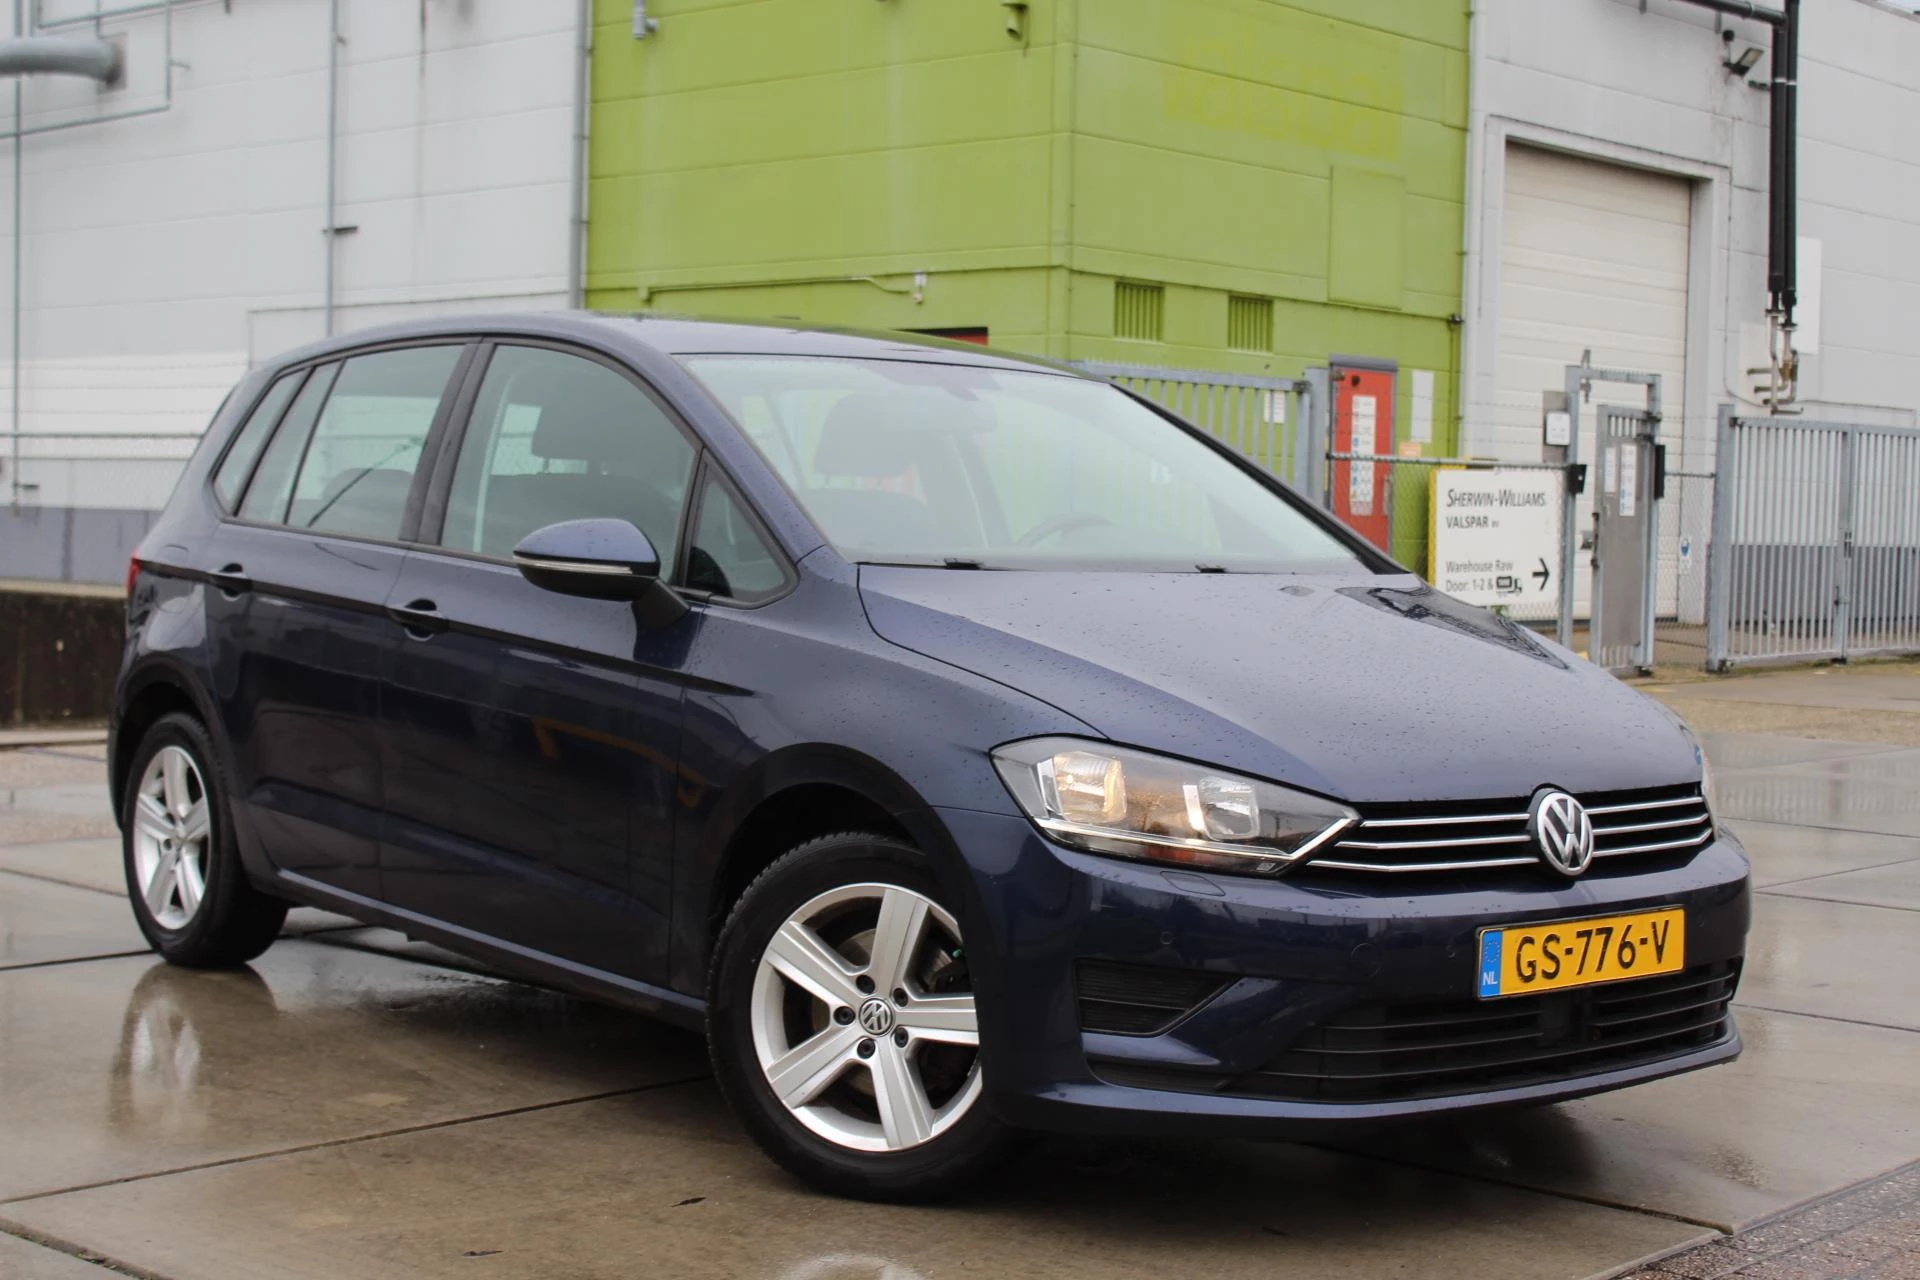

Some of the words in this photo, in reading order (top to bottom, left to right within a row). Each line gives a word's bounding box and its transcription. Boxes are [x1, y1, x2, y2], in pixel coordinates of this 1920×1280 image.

[1446, 515, 1488, 528] VALSPAR
[1446, 560, 1493, 573] Warehouse
[1496, 560, 1513, 571] Raw
[1516, 919, 1669, 983] GS-776-V
[1482, 971, 1498, 985] NL
